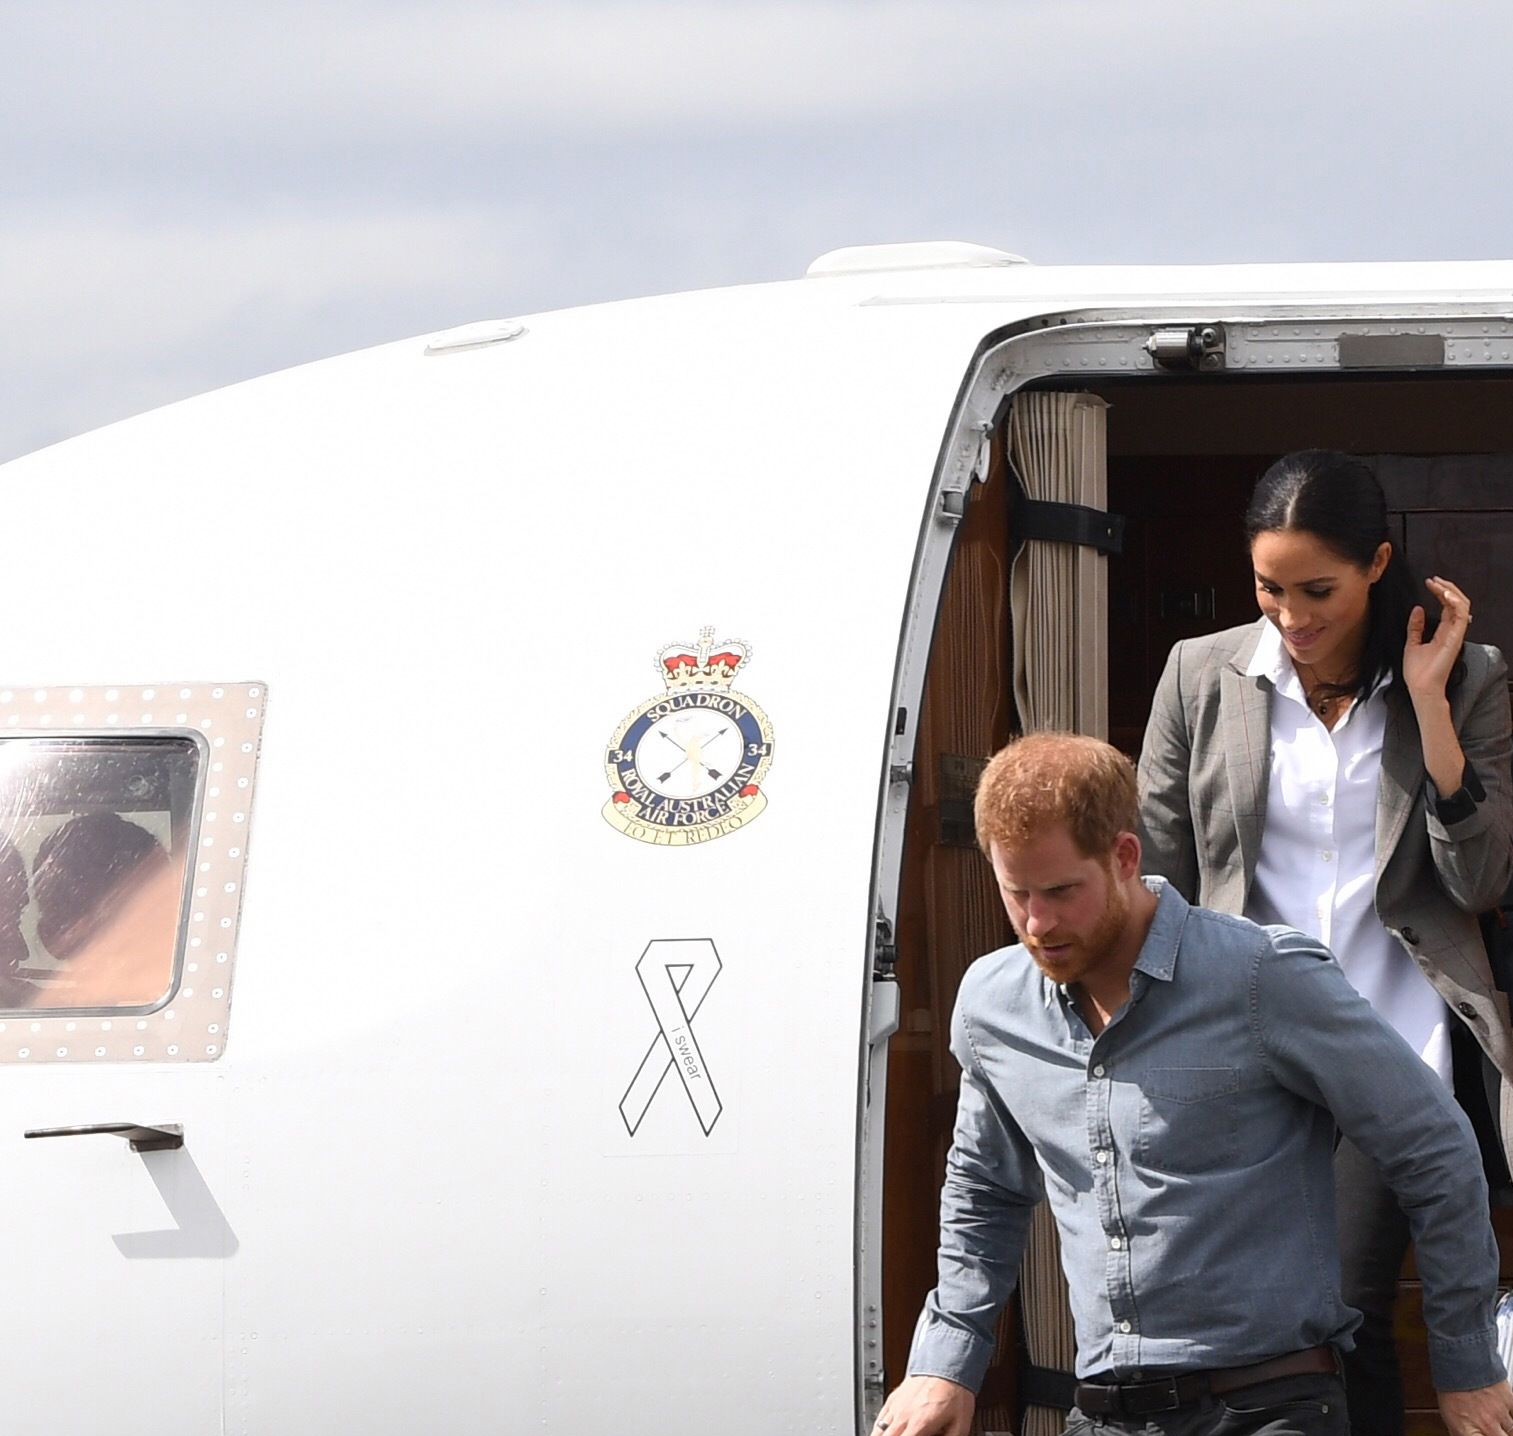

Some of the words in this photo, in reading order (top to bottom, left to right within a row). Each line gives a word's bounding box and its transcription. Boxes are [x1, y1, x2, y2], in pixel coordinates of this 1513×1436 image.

[646, 694, 748, 722] SQUADRON
[612, 750, 634, 763] 34
[747, 743, 768, 757] 34
[620, 769, 657, 808] ROYAL
[656, 763, 755, 813] AUSTRALIAN
[639, 808, 667, 825] AIR
[672, 801, 729, 826] FORCE
[674, 1035, 702, 1080] swear
